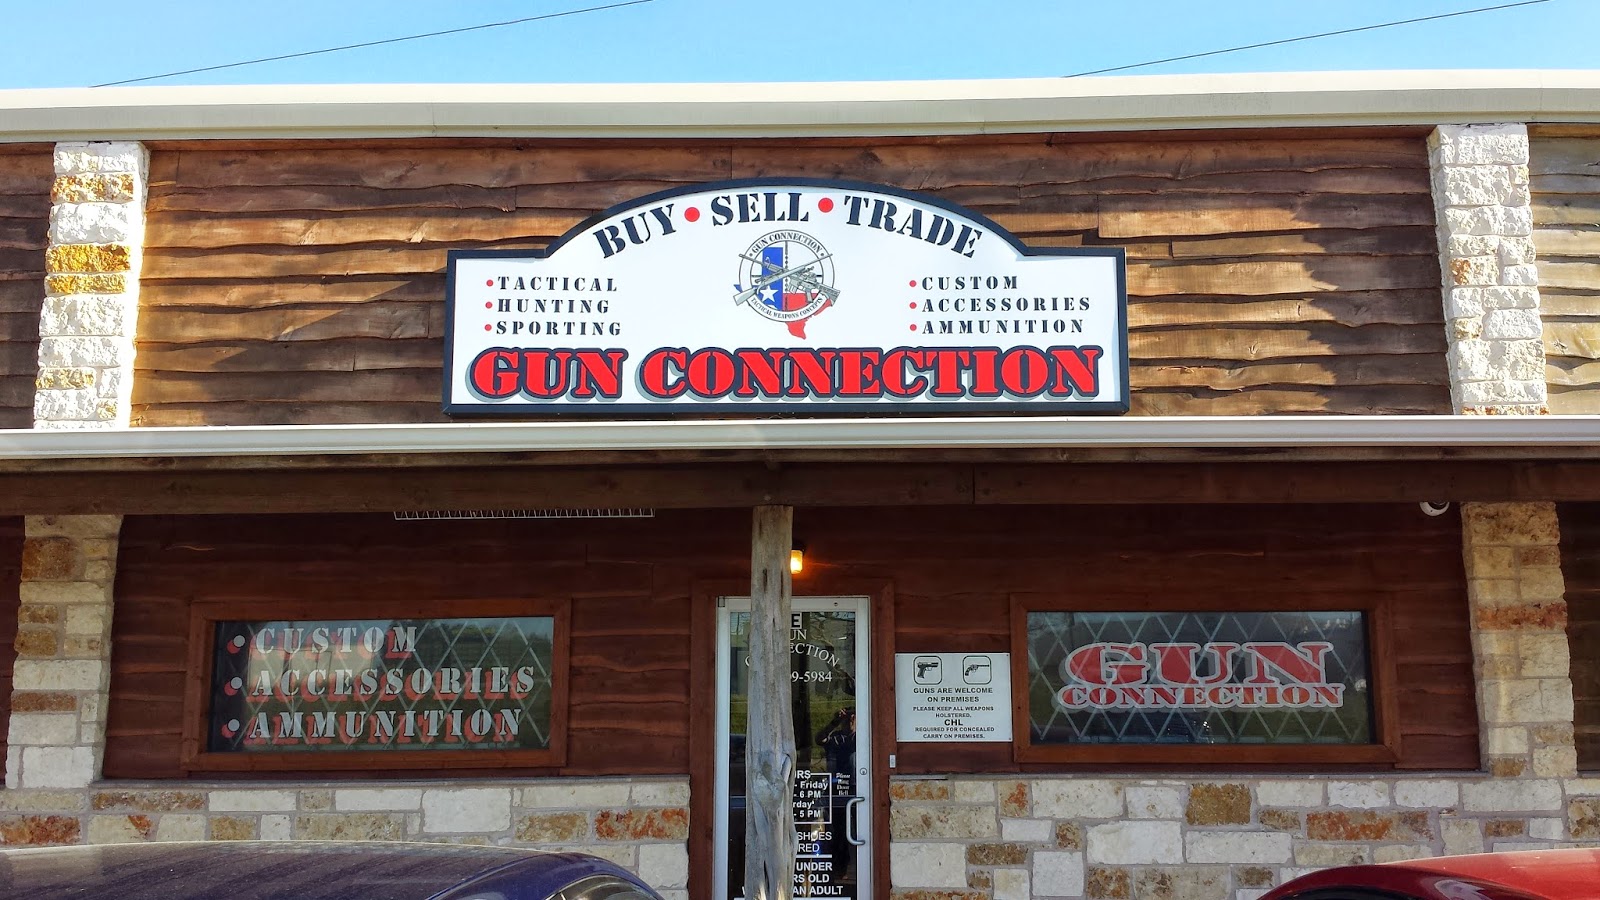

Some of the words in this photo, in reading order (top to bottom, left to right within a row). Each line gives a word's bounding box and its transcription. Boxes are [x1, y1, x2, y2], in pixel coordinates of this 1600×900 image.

[592, 203, 677, 259] BUY
[710, 192, 810, 227] SELL
[843, 194, 983, 259] TRADE
[751, 237, 769, 254] GUN
[769, 231, 823, 254] CONNECTION
[497, 276, 618, 292] TACTICAL
[921, 275, 1018, 290] CUSTOM
[497, 298, 610, 314] HUNTING
[750, 297, 773, 317] TACTICAL
[773, 311, 799, 320] WEAPONS
[921, 297, 1091, 313] ACCESSORIES
[496, 320, 621, 336] SPORTING
[921, 319, 1084, 335] AMMUNITION
[468, 347, 629, 400] GUN
[637, 345, 1104, 399] CONNECTION
[255, 626, 418, 655] CUSTOM
[790, 629, 807, 640] UN
[1064, 642, 1334, 686] GUN
[252, 666, 535, 696] ACCESSORIES
[791, 670, 832, 682] 9-5984
[1058, 683, 1346, 709] CONNECTION
[250, 708, 522, 739] AMMUNITION
[800, 781, 828, 790] Friday
[800, 790, 804, 798] 6
[807, 790, 821, 798] PM
[792, 800, 812, 810] rday
[800, 810, 804, 818] 5
[807, 810, 821, 818] PM
[797, 831, 832, 841] SHOES
[796, 862, 833, 871] UNDER
[808, 874, 829, 883] OLD
[809, 886, 843, 895] ADULT
